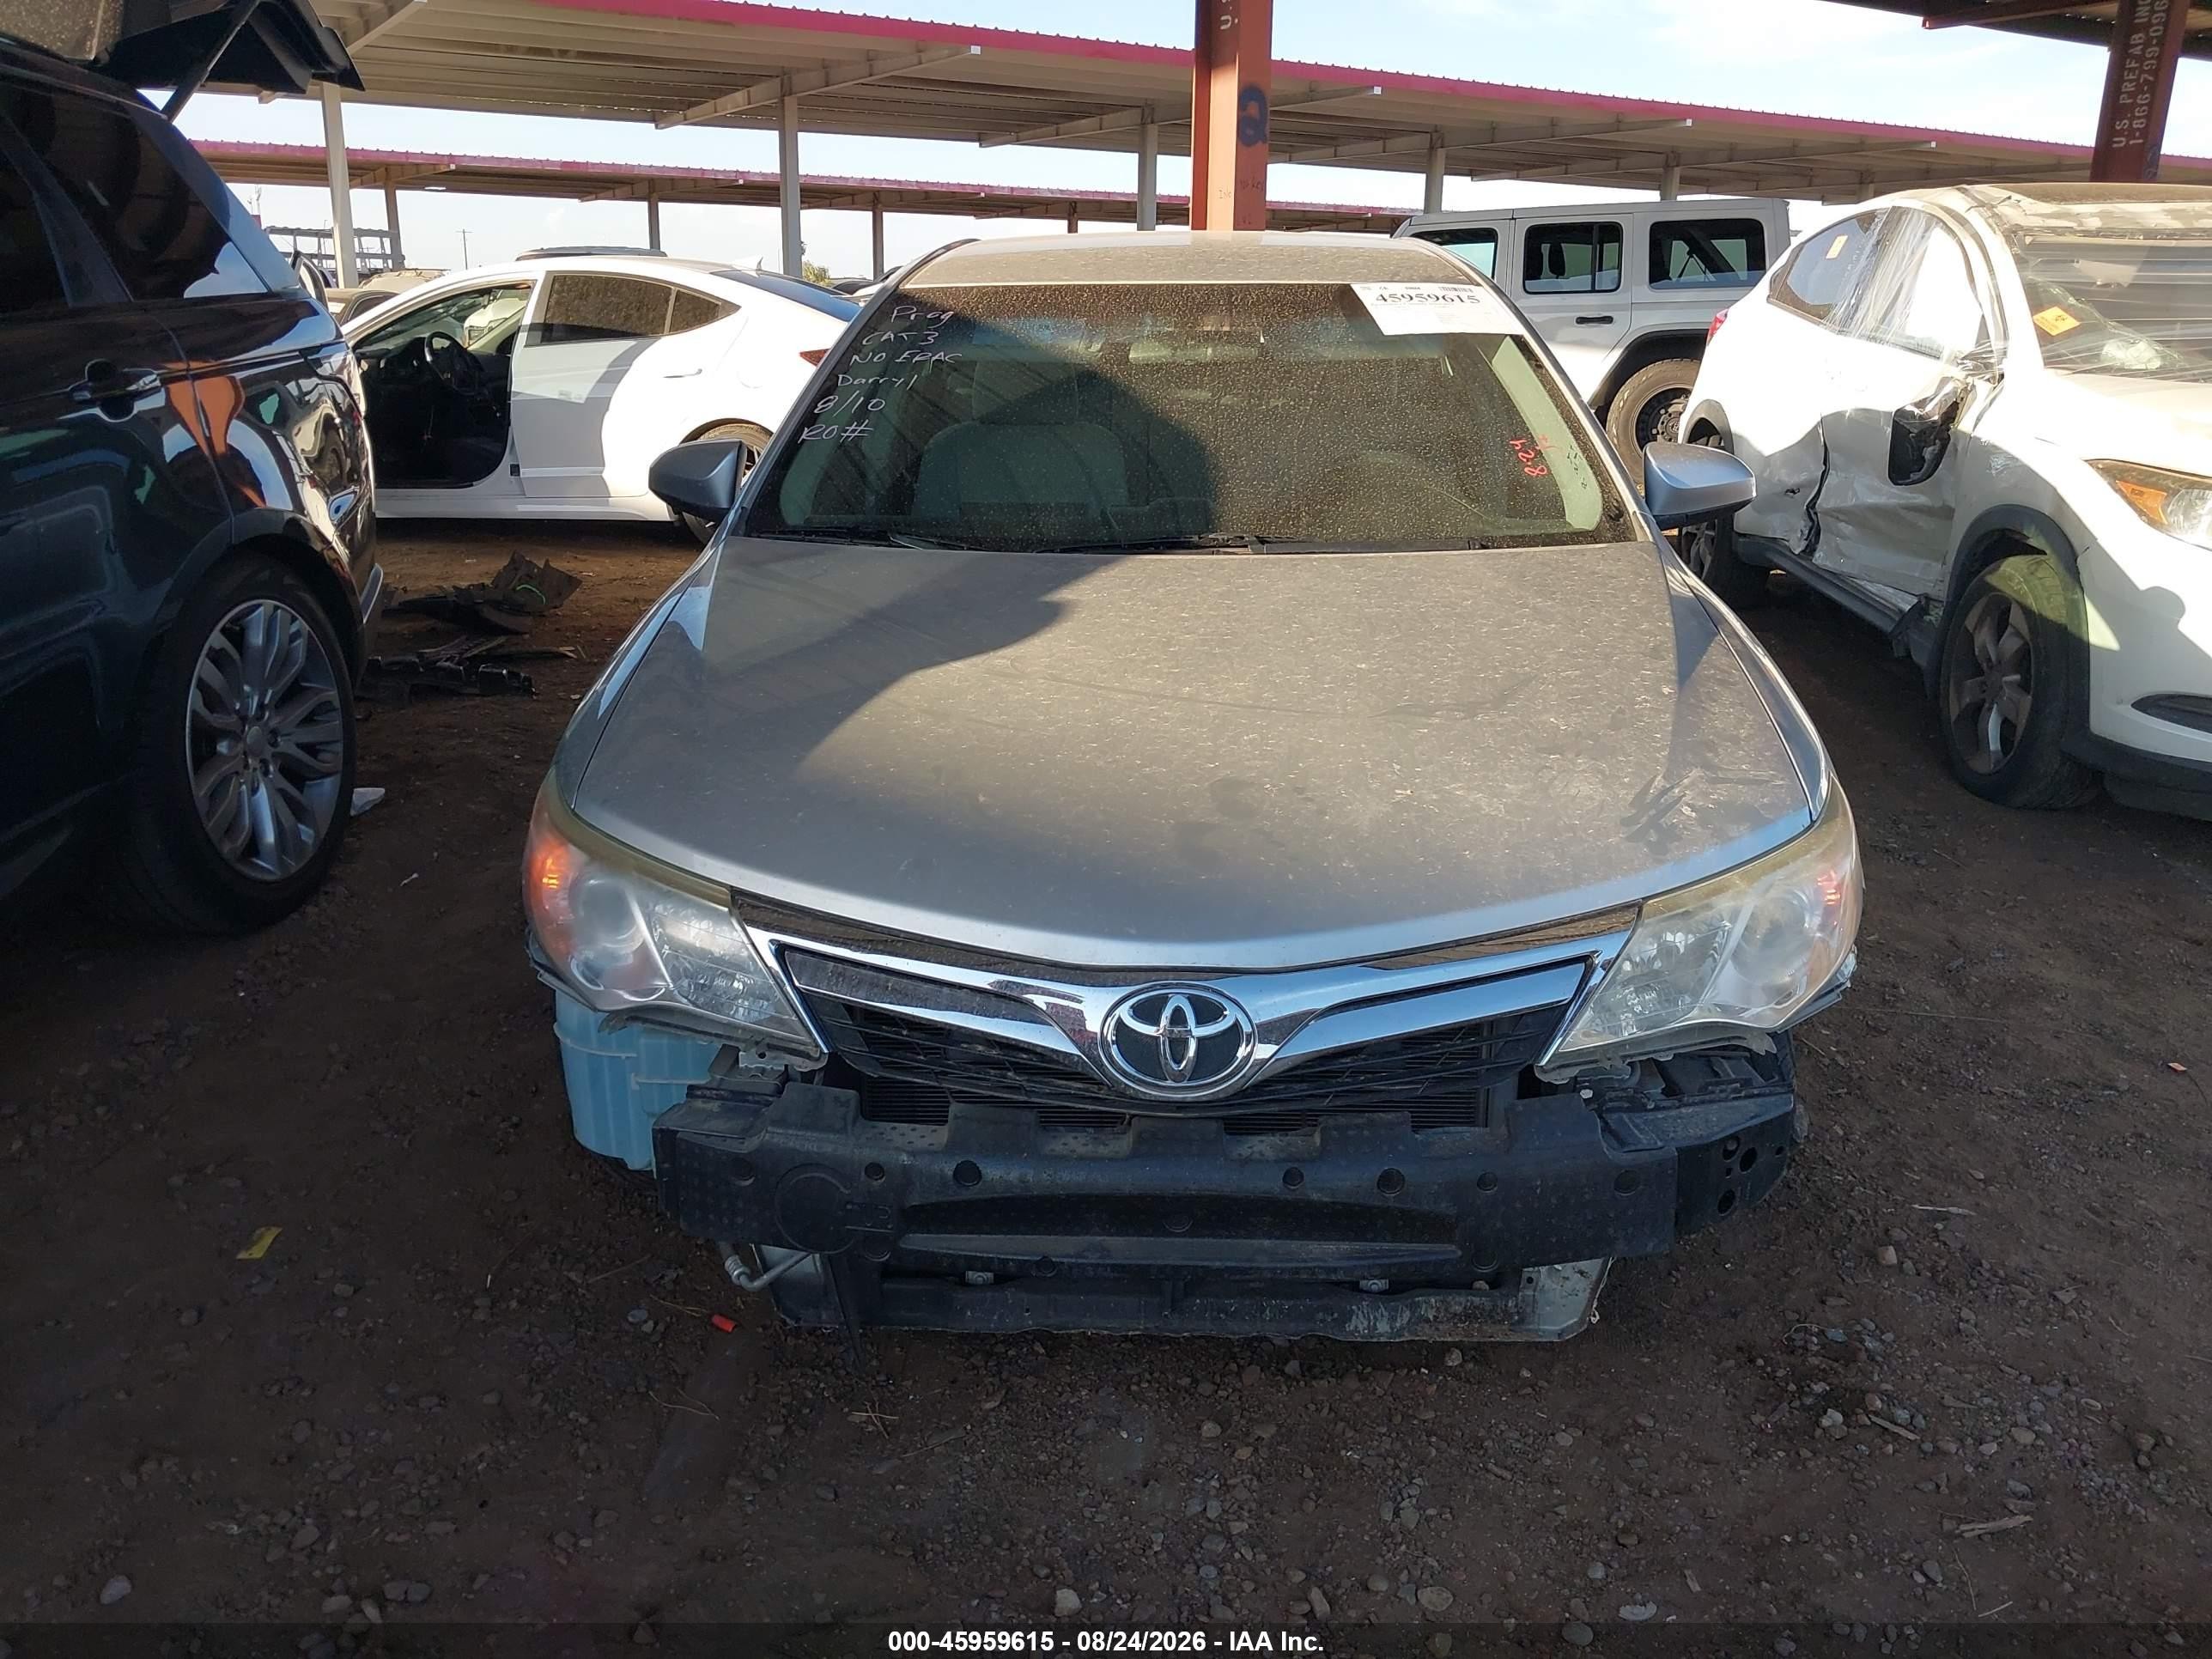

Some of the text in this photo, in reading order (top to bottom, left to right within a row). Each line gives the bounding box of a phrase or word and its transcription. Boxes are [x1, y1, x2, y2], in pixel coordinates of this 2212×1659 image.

[2119, 33, 2146, 104] PREFAB
[2112, 113, 2131, 149] U.S.
[1376, 293, 1481, 304] 45959615
[890, 305, 955, 329] Prog
[862, 331, 918, 346] CAT
[814, 390, 886, 417] 8/10
